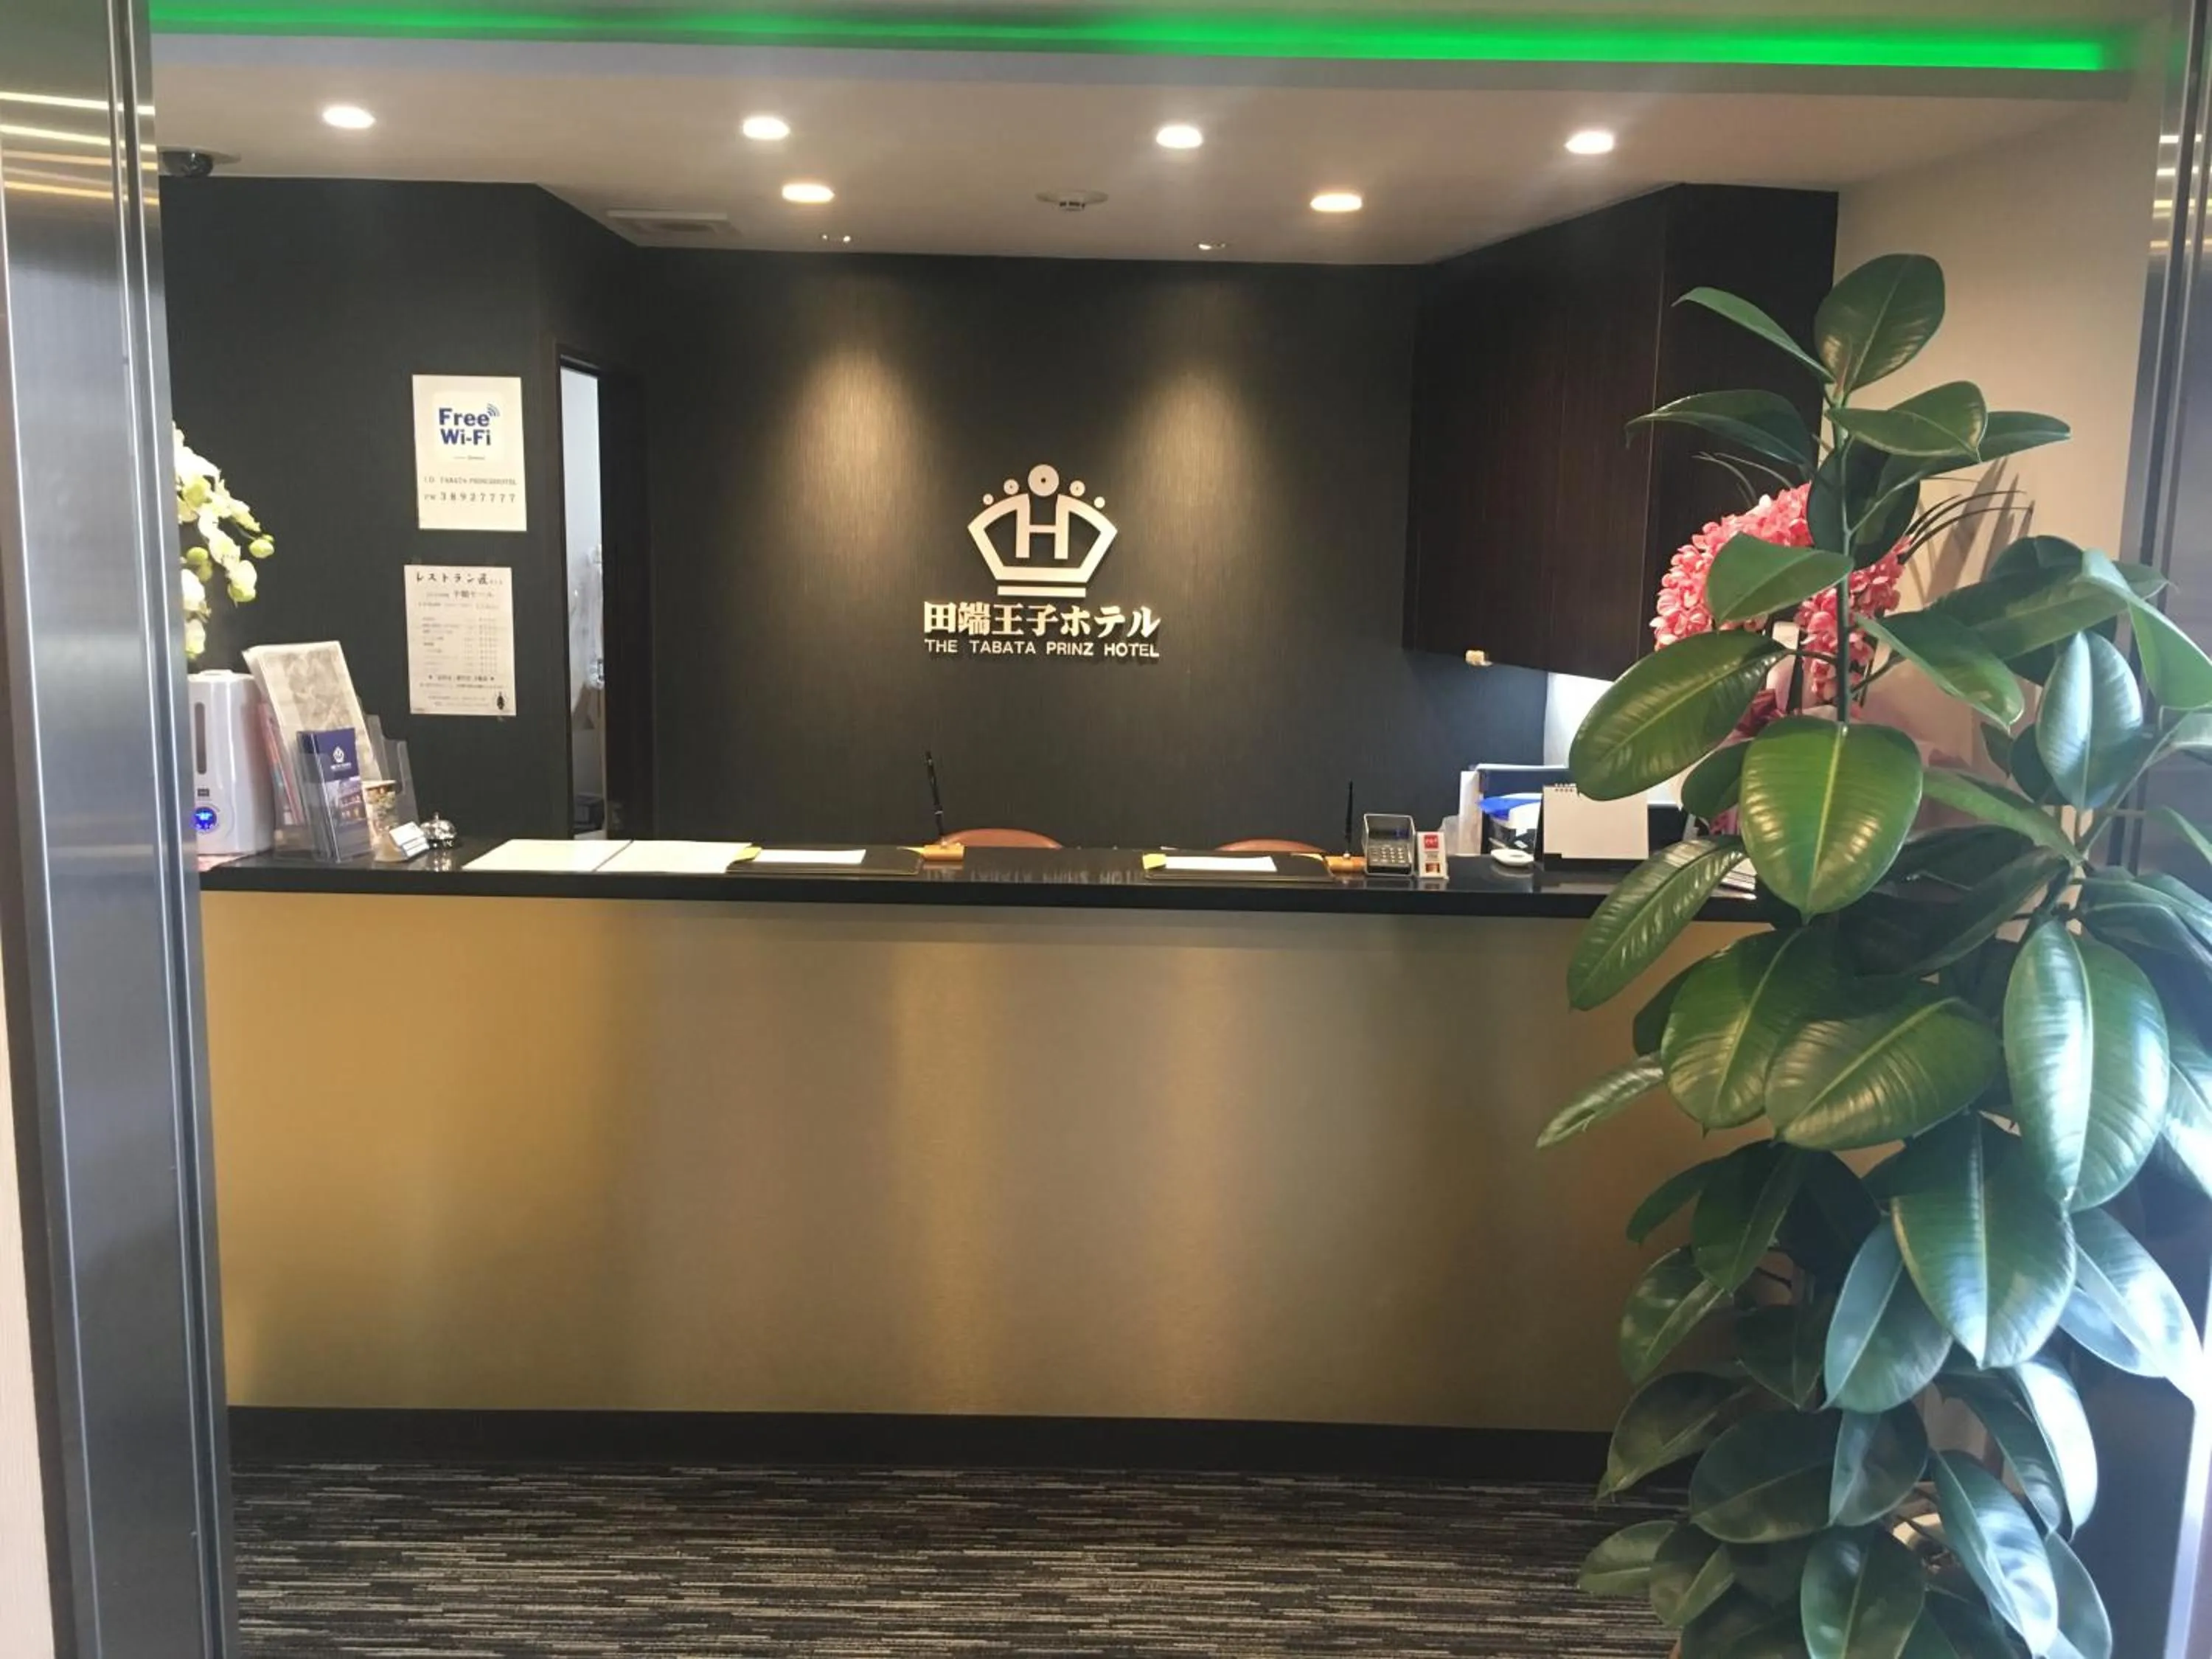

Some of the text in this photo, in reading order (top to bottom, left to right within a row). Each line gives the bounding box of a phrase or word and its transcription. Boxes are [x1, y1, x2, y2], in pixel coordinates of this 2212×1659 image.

[439, 408, 490, 426] Free
[440, 428, 491, 445] Wi-Fi
[924, 601, 1161, 639] 田端王子ホテル
[924, 639, 1160, 658] THE TABATA PRINZ HOTEL
